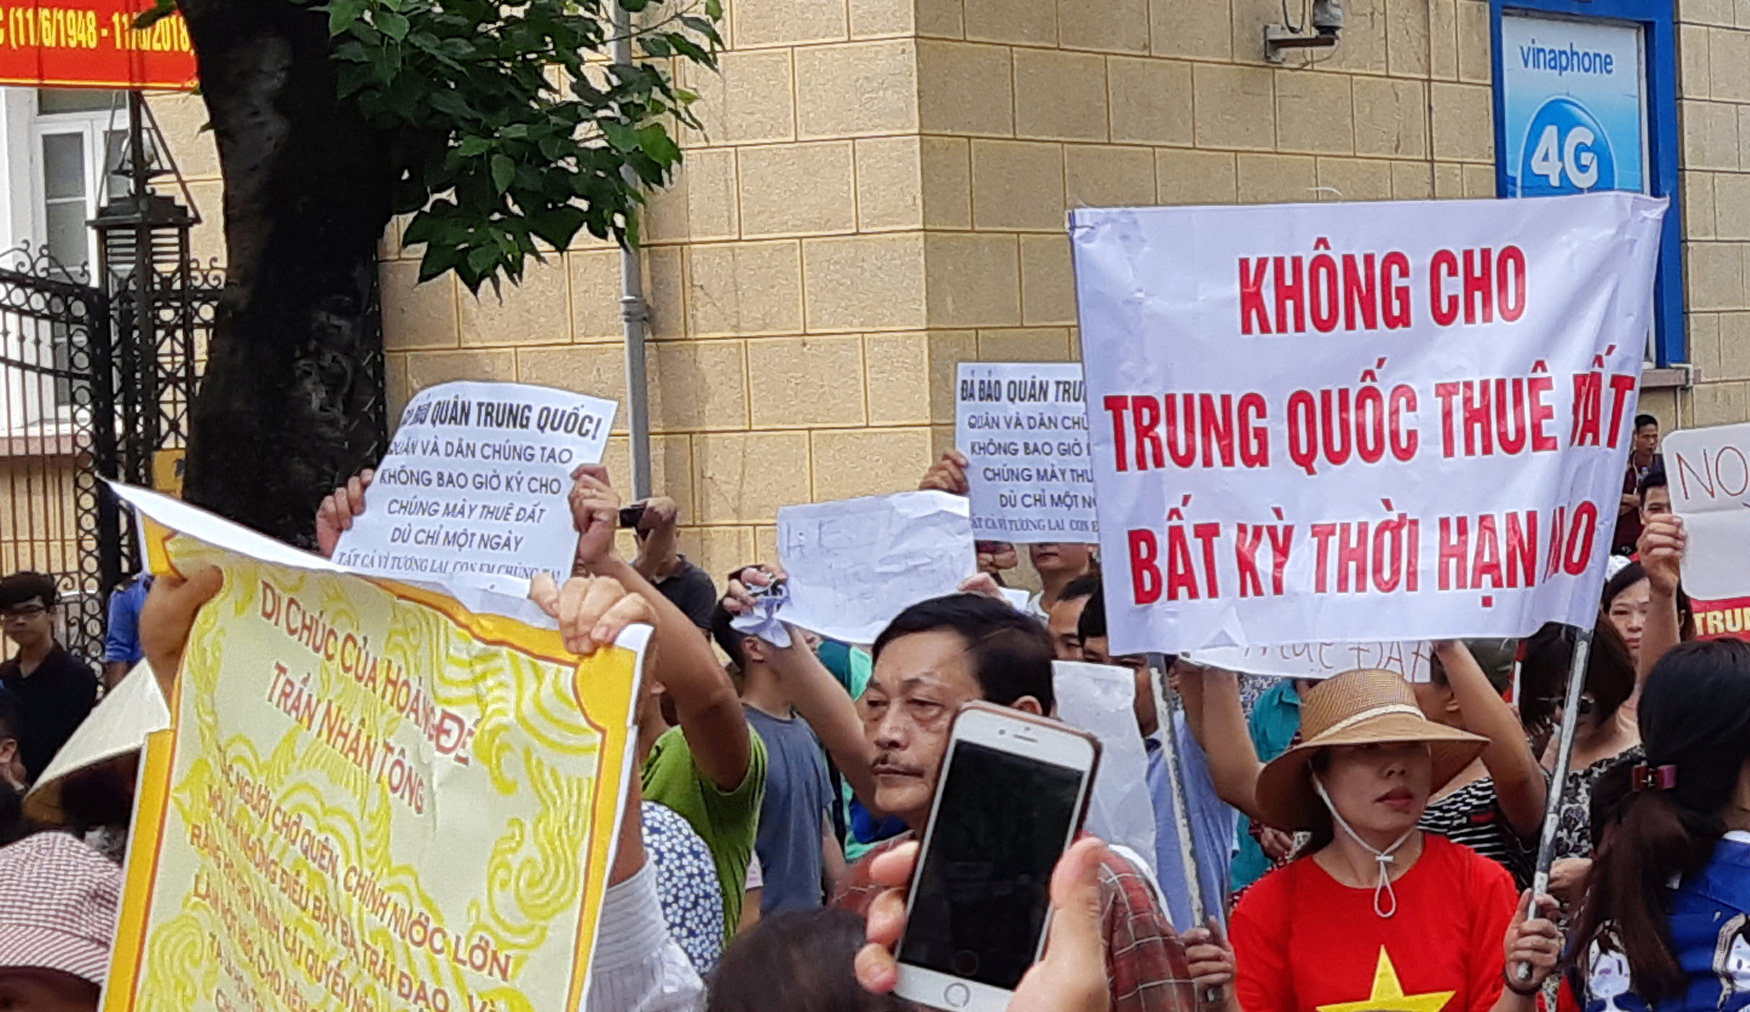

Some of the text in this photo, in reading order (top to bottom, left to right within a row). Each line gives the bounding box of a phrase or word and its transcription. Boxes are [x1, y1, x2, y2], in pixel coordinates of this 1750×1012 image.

[9, 7, 98, 49] (11/6/1948
[1520, 39, 1614, 76] vinaphone
[1531, 124, 1599, 190] 4G
[1238, 237, 1527, 335] KHÔNG CHO
[960, 370, 1086, 404] ĐẢ ĐẢO QUÂN TRU
[430, 399, 603, 441] QUÂN TRUNG QUỐC!
[968, 411, 1058, 430] QUÂN VÀ DÂN
[1103, 392, 1270, 473] TRUNG
[1286, 357, 1419, 476] QUỐC
[1434, 359, 1558, 457] THUÊ
[420, 435, 573, 464] VÀ DÂN CHÚNG TAO
[970, 439, 1019, 457] KHÔNG
[1023, 442, 1053, 456] BAO
[1057, 439, 1083, 457] GIỜ
[379, 464, 562, 495] KHÔNG BAO GIỜ KÝ CHO
[983, 463, 1067, 483] CHÚNG MÀY
[387, 494, 546, 524] CHÚNG MÀY THUÊ ĐẤT
[1000, 489, 1017, 508] DÙ
[1021, 489, 1048, 509] CHỈ
[1050, 490, 1083, 512] MỘT
[390, 523, 524, 553] DÙ CHỈ MỘT NGÀY
[1048, 518, 1064, 532] LAI
[338, 549, 360, 567] TẤT
[362, 549, 376, 567] CẢ
[430, 558, 448, 573] LAI
[1127, 495, 1220, 606] BẤT
[1234, 506, 1295, 598] KỲ
[1310, 498, 1419, 594] THỜI
[1437, 511, 1537, 608] HẠN
[260, 581, 281, 626] DI
[285, 598, 339, 663] CHÚC
[341, 633, 378, 692] CỦA
[267, 661, 321, 732] TRẦN
[322, 698, 378, 781] NHÂN
[375, 739, 427, 816] TÔNG
[272, 804, 303, 846] CHỚ
[342, 865, 394, 929] CHÍNH
[390, 902, 447, 958] NƯỚC
[453, 934, 513, 984] LỚN
